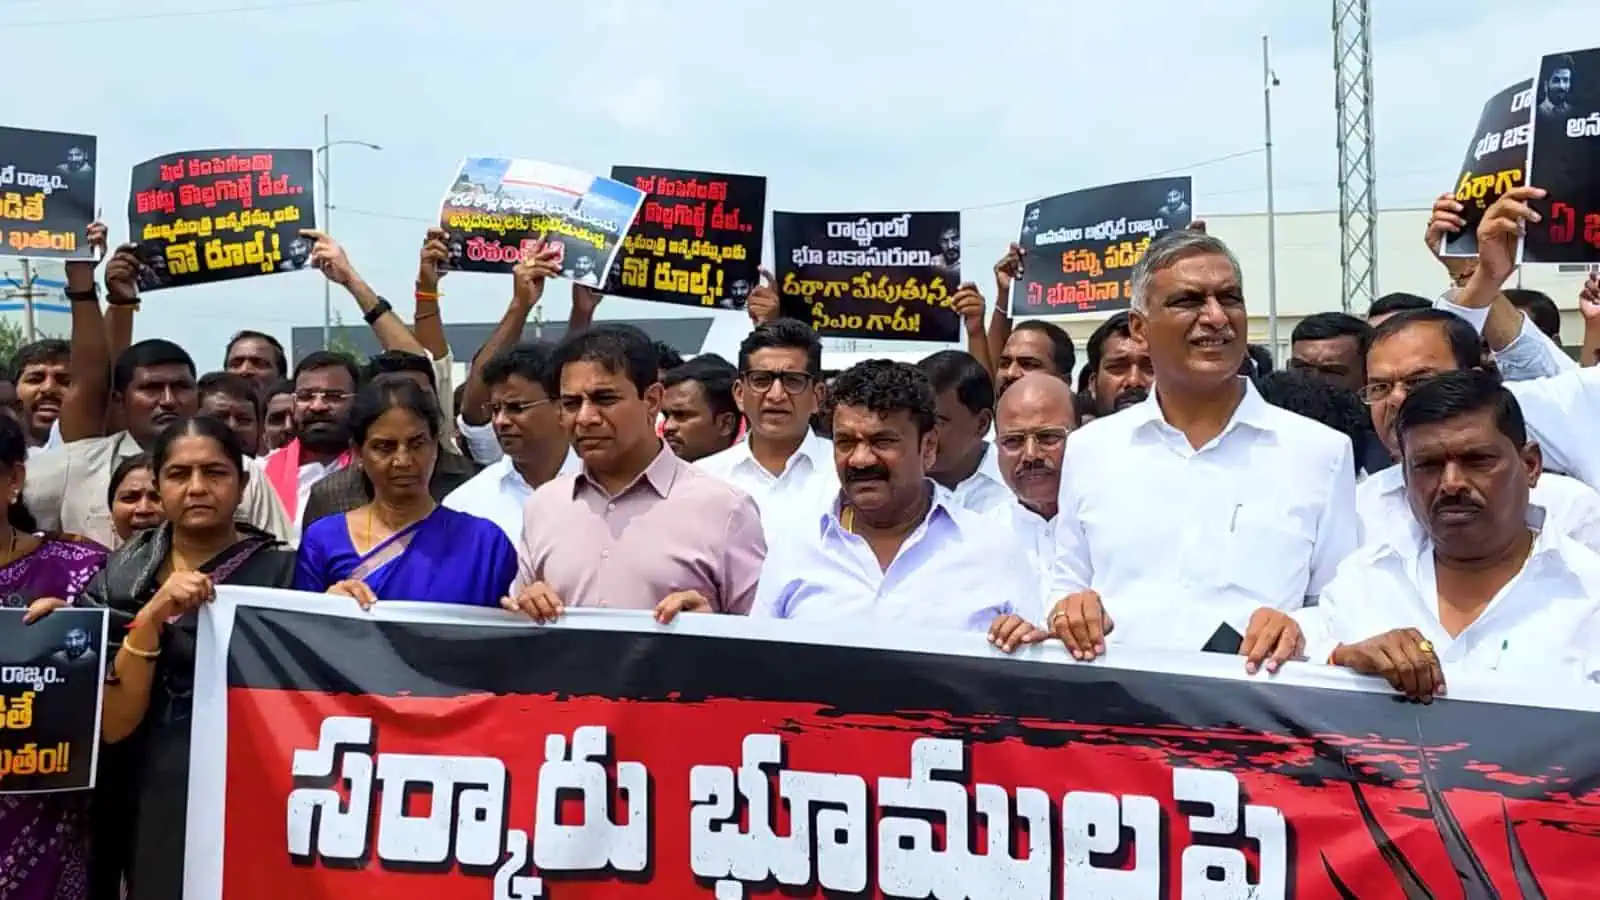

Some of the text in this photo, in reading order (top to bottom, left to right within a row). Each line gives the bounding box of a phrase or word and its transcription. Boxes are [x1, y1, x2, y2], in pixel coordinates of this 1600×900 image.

[0, 192, 46, 221] డితే
[827, 214, 912, 247] రాష్ట్రంలో
[165, 240, 199, 275] నో
[792, 245, 823, 267] భూ
[1062, 248, 1104, 277] కన్ను
[622, 257, 649, 288] నో
[852, 271, 952, 307] మేపుతున్న
[1027, 281, 1043, 306] ఏ
[811, 302, 921, 332] సీఎం గారు!
[287, 716, 648, 900] సర్కారు
